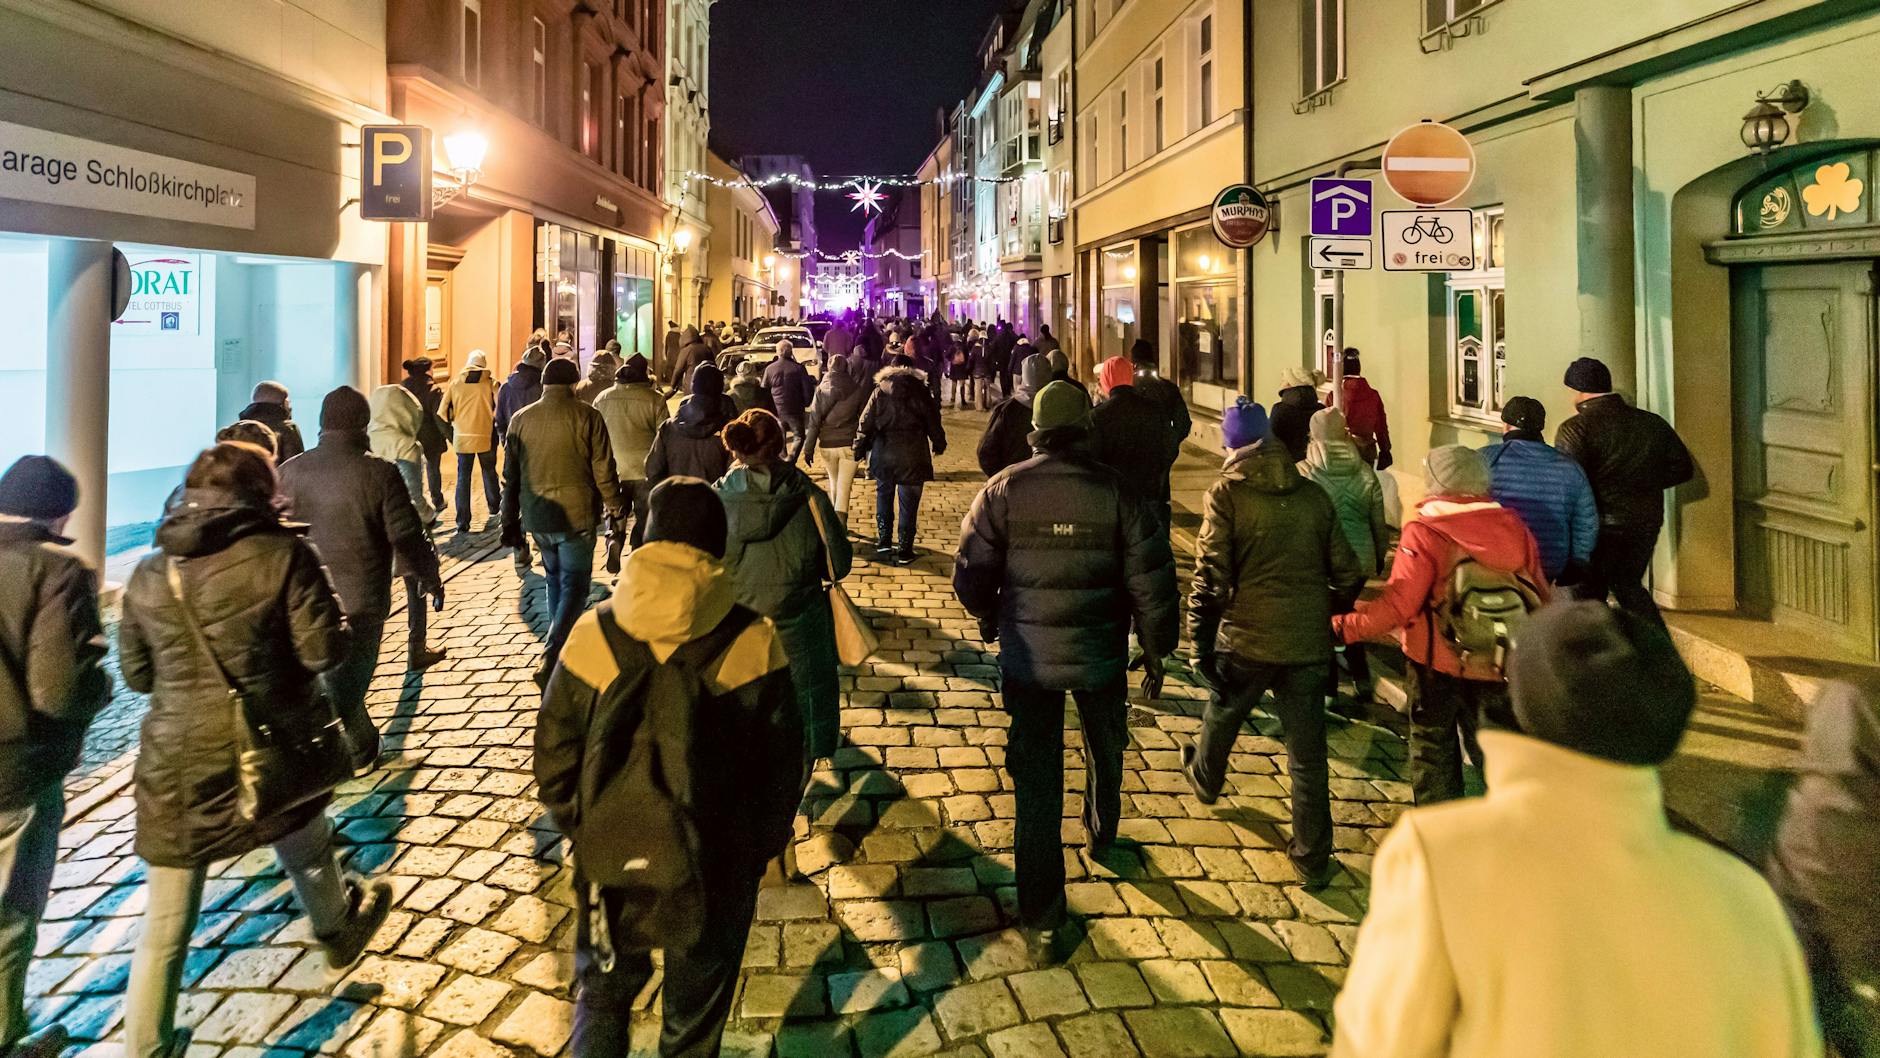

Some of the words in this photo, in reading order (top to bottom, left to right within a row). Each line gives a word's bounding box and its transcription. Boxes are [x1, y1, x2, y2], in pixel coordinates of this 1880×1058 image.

[373, 132, 413, 186] P
[385, 195, 401, 204] frei
[1331, 198, 1357, 231] P
[1415, 251, 1444, 264] frei
[144, 301, 183, 311] COTTBUS
[1053, 523, 1074, 536] HH
